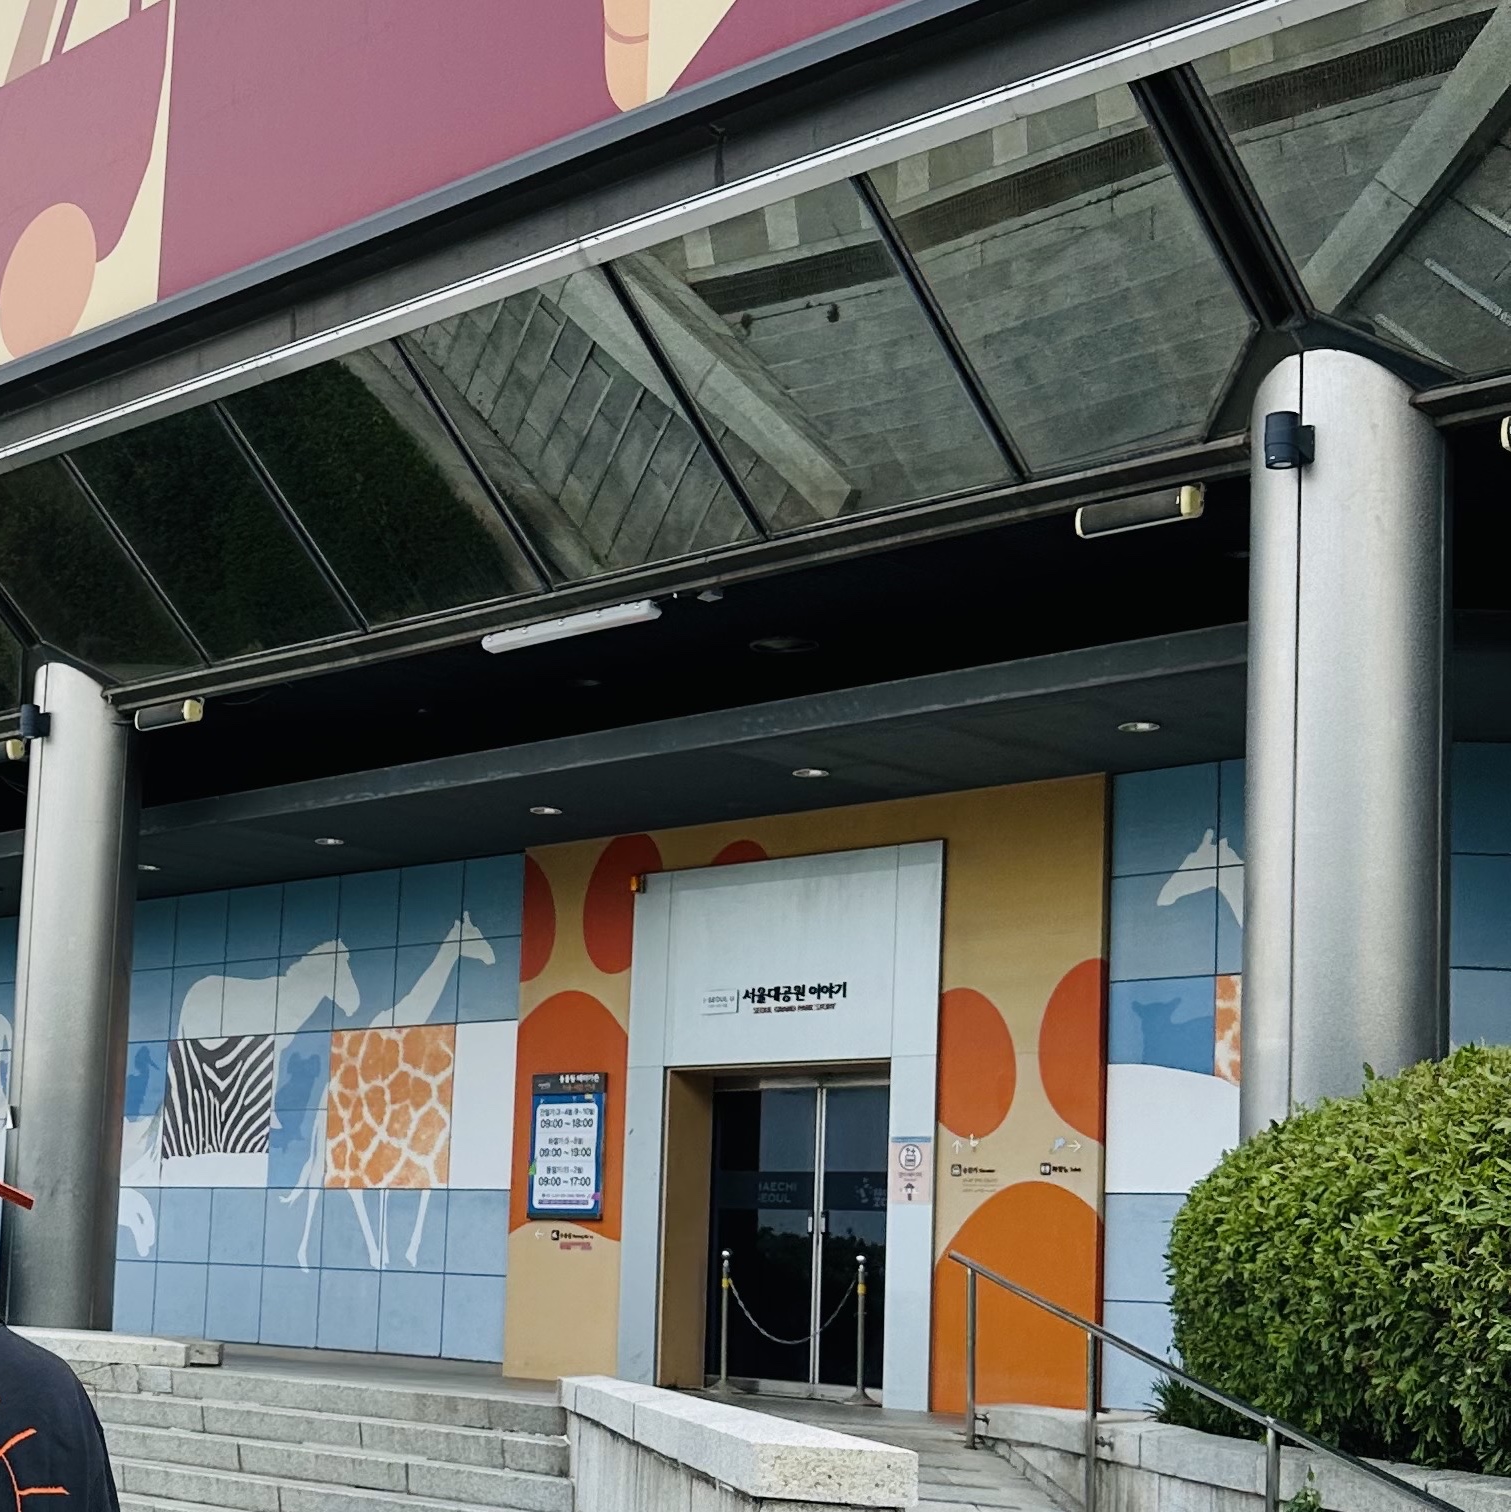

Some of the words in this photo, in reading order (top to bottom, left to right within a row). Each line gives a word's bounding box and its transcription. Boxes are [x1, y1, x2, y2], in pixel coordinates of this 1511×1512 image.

[742, 983, 806, 1004] 서울대공원
[808, 981, 847, 1000] 이야기
[540, 1119, 563, 1128] 09:00
[539, 1148, 562, 1157] 09:00
[538, 1176, 561, 1186] 09:00
[569, 1176, 591, 1187] 17:00
[758, 1193, 791, 1204] EOUL
